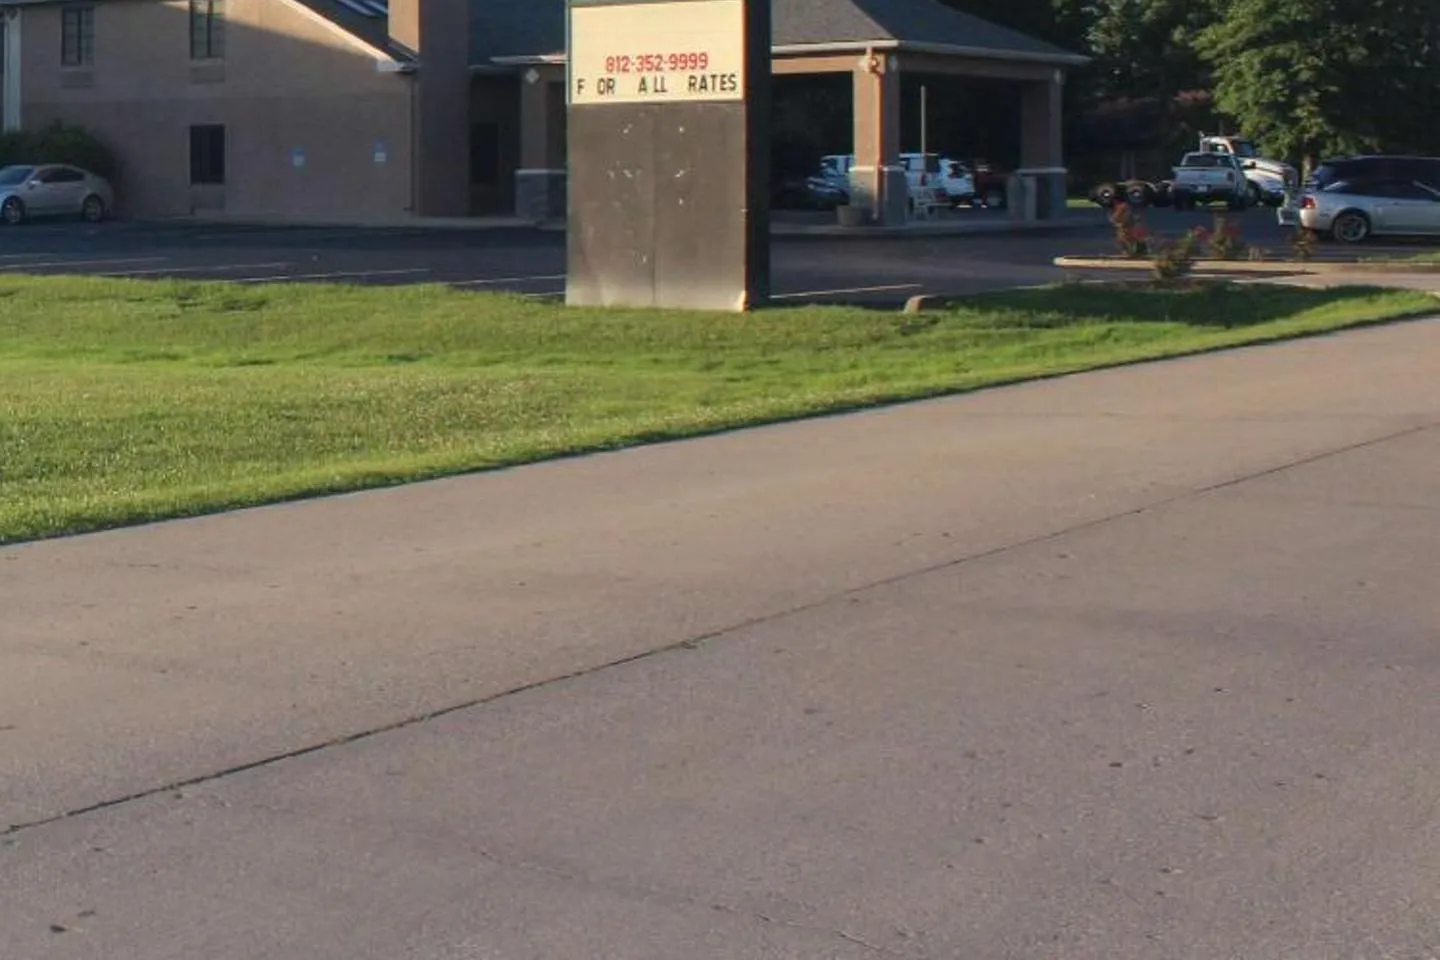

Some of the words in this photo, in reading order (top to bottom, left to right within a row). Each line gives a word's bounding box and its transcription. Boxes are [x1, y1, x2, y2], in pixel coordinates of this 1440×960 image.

[605, 52, 709, 73] 812-352-9999
[638, 76, 668, 93] ALL
[688, 73, 737, 93] RATES
